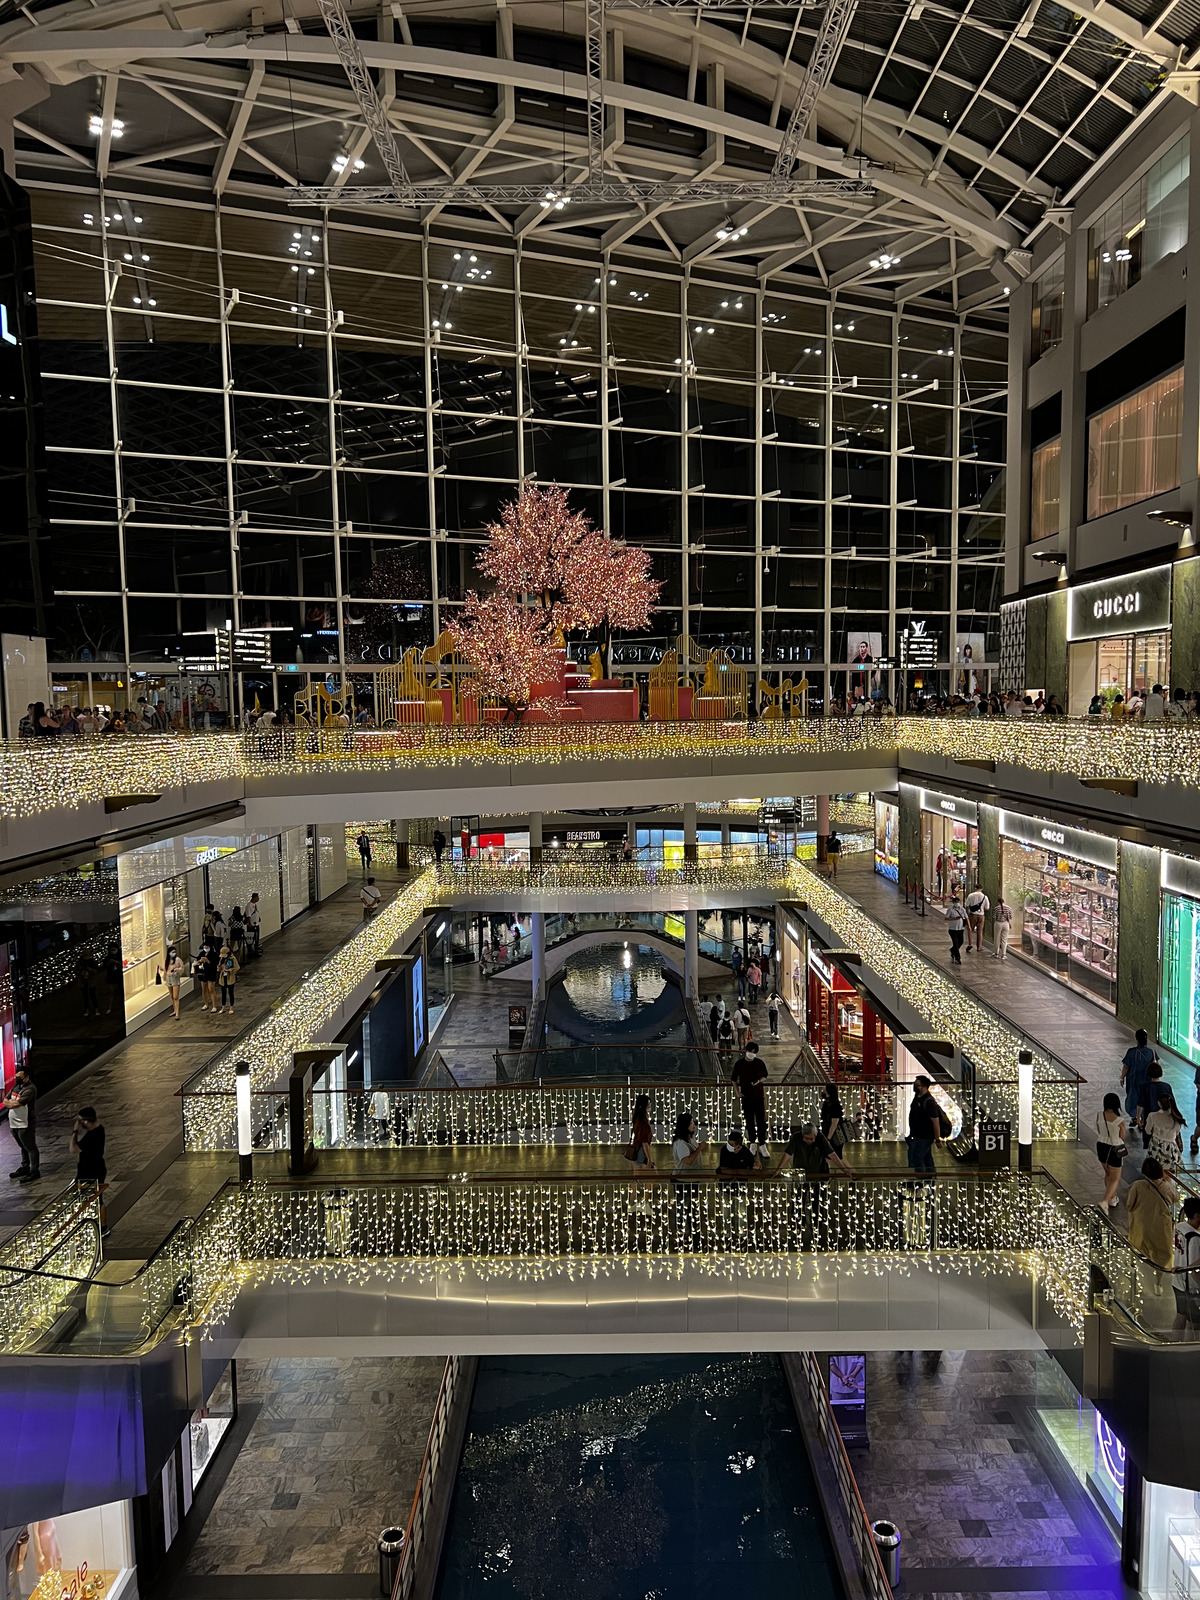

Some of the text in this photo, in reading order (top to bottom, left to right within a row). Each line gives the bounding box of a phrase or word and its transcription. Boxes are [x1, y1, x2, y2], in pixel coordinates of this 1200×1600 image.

[1093, 591, 1140, 619] GUCCI
[1041, 828, 1065, 845] GUCCI
[985, 1134, 1004, 1151] B1
